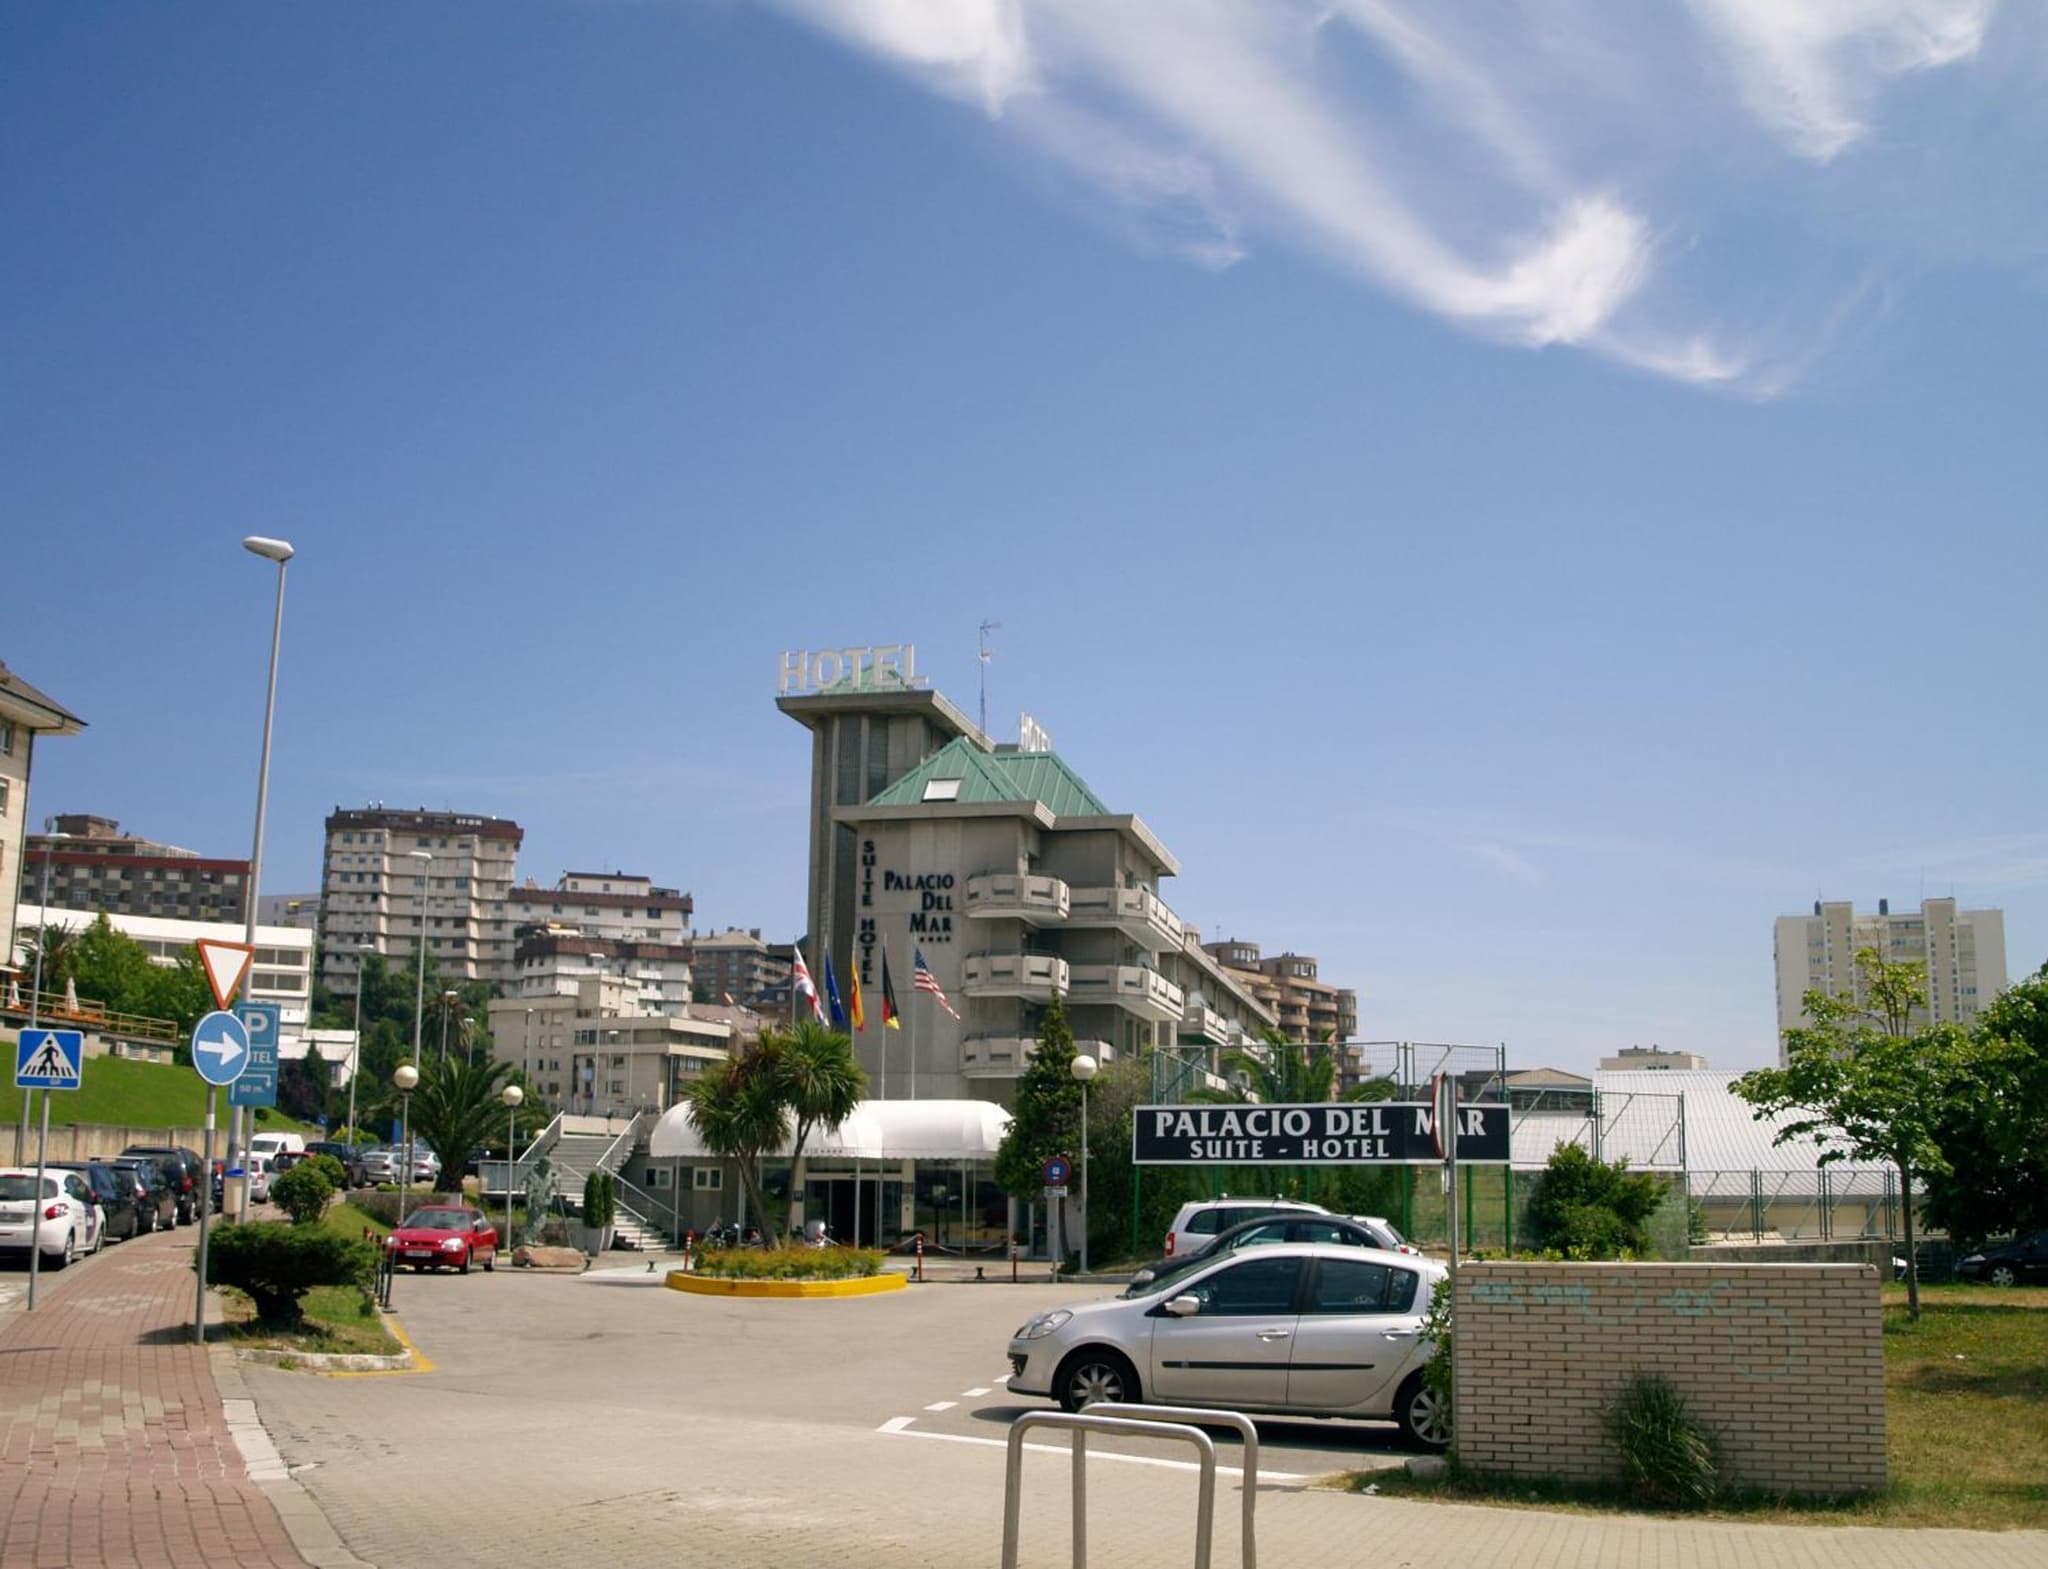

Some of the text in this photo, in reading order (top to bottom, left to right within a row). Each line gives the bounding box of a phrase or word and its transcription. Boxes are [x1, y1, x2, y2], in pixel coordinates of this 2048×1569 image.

[779, 643, 929, 692] HOTEL
[859, 840, 876, 985] SUITE HOTEL
[245, 1012, 267, 1037] P
[1155, 1110, 1312, 1138] PALACIO
[1325, 1108, 1391, 1136] DEL
[1190, 1139, 1265, 1158] SUITE
[1303, 1138, 1390, 1158] HOTEL
